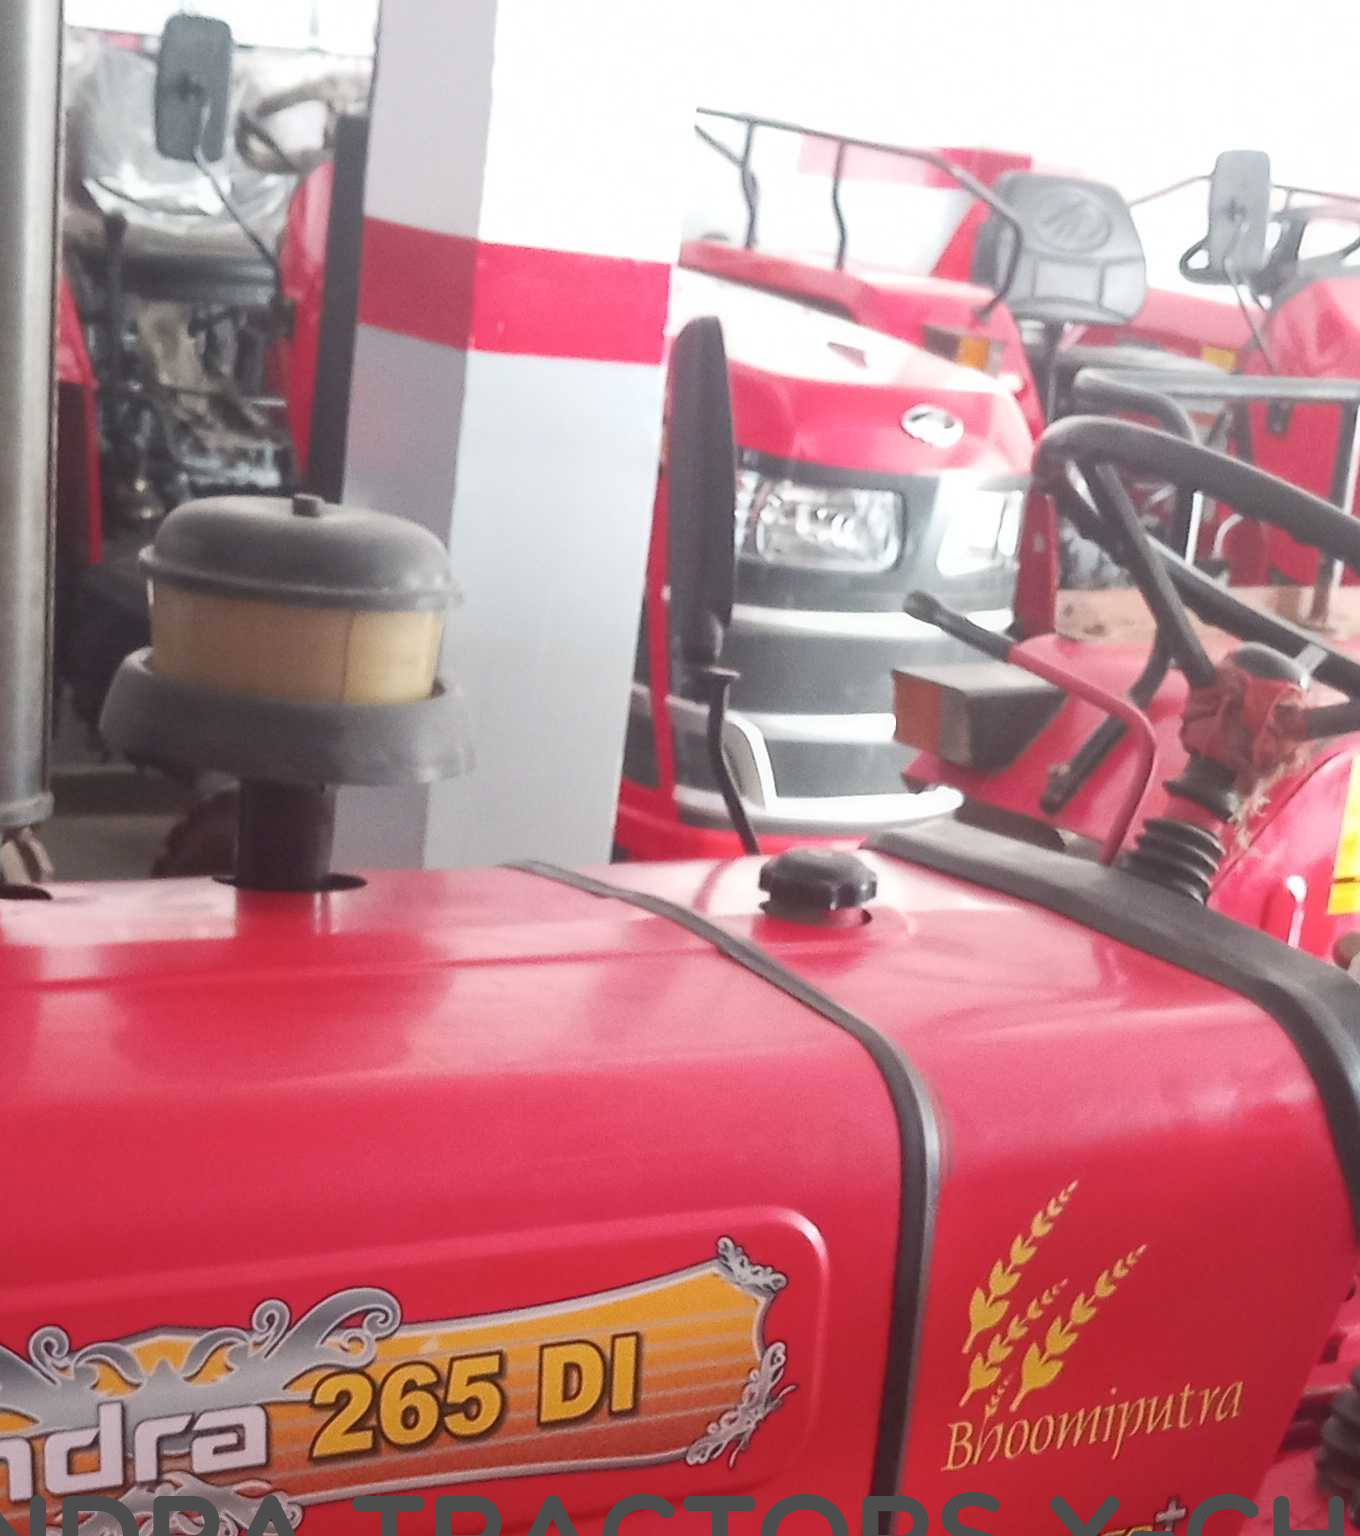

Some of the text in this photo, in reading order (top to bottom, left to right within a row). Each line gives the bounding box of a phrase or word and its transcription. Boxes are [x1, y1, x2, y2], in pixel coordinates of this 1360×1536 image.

[309, 1350, 507, 1461] 265
[537, 1331, 640, 1427] DI
[940, 1379, 1244, 1472] Bhoomiputra
